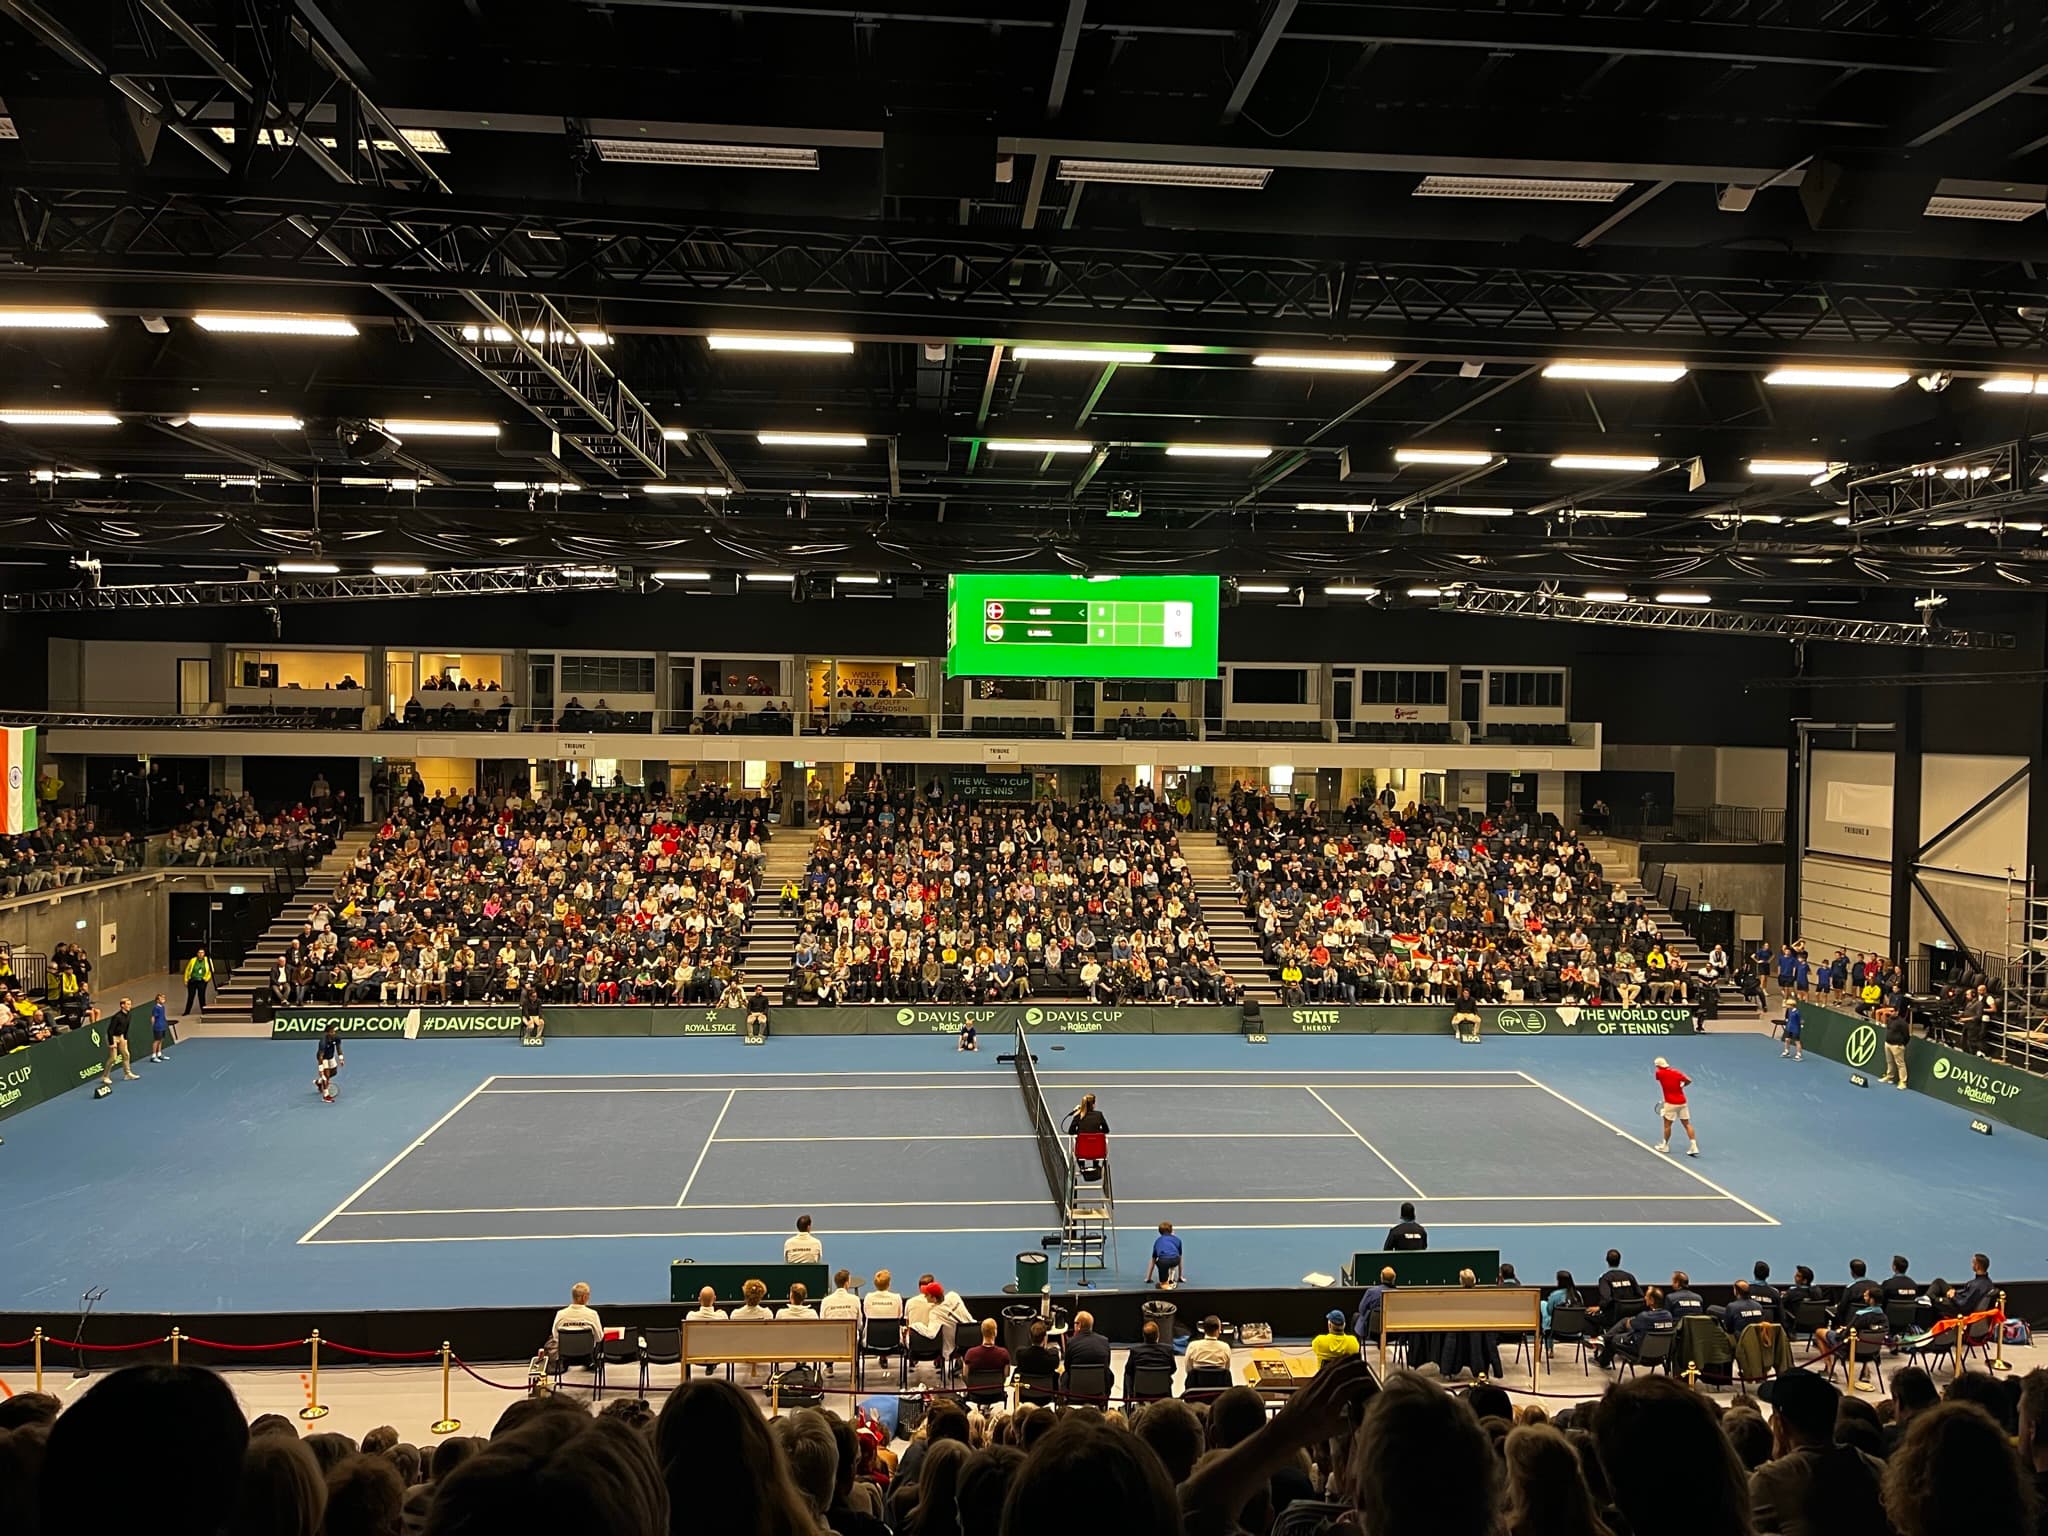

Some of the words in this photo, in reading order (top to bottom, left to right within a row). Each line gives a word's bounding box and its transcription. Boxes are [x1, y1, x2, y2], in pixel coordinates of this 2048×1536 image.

[952, 777, 971, 785] THE
[1009, 778, 1030, 786] CUP
[964, 787, 978, 795] OF
[918, 1011, 960, 1022] DAVIS
[964, 1011, 995, 1021] CUP
[1047, 1011, 1088, 1021] DAVIS
[1092, 1011, 1122, 1021] CUP
[1580, 1009, 1605, 1020] THE
[1608, 1009, 1658, 1020] WORLD
[1661, 1009, 1690, 1021] CUP
[274, 1017, 407, 1032] DAVISCUP.COM
[423, 1016, 521, 1030] #DAVISCUP
[685, 1024, 710, 1032] ROYAL
[711, 1024, 736, 1032] STAGE
[1068, 1022, 1102, 1031] Rakuten
[1597, 1023, 1616, 1034] OF
[7, 1066, 31, 1086] CUP
[1950, 1066, 1989, 1089] DAVIS
[1991, 1080, 2019, 1098] CUP
[1964, 1085, 1995, 1104] Rakuten
